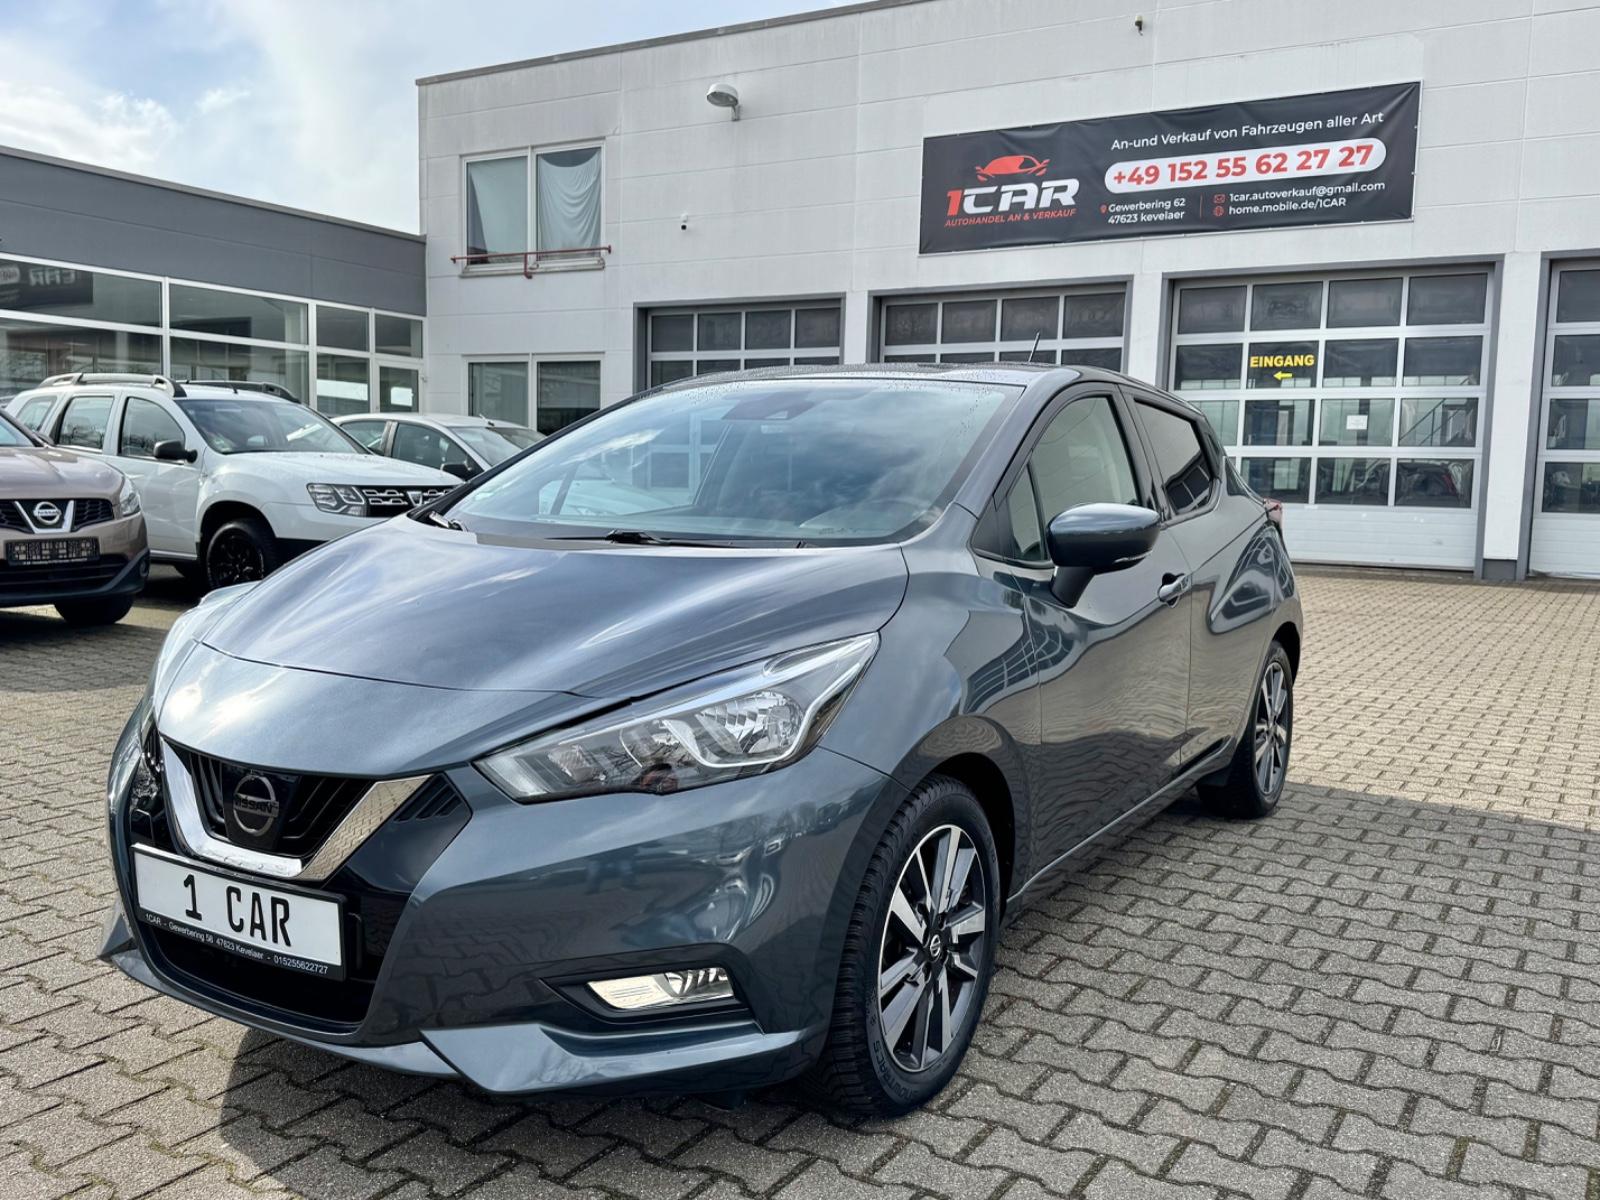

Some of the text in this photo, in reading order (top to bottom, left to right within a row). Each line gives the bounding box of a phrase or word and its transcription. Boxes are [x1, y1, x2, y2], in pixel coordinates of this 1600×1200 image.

[1110, 111, 1385, 151] An-und Verkauf von Fahrzeugen aller Art
[1113, 144, 1374, 186] +49 152 55 62 27 27
[947, 178, 1080, 217] 1CAR
[1229, 182, 1385, 202] 1car.autoverkauf@gmail.com
[1108, 197, 1187, 213] Gewerbering 62
[1228, 196, 1347, 216] home.mobile.de/1CAR
[944, 207, 1078, 228] AUTOHANDEL AN & VERKAUF
[1107, 210, 1186, 225] 47623 kevelaer
[1249, 354, 1316, 368] EINGANG
[145, 913, 162, 927] 1CAR
[184, 874, 292, 947] 1 CAR
